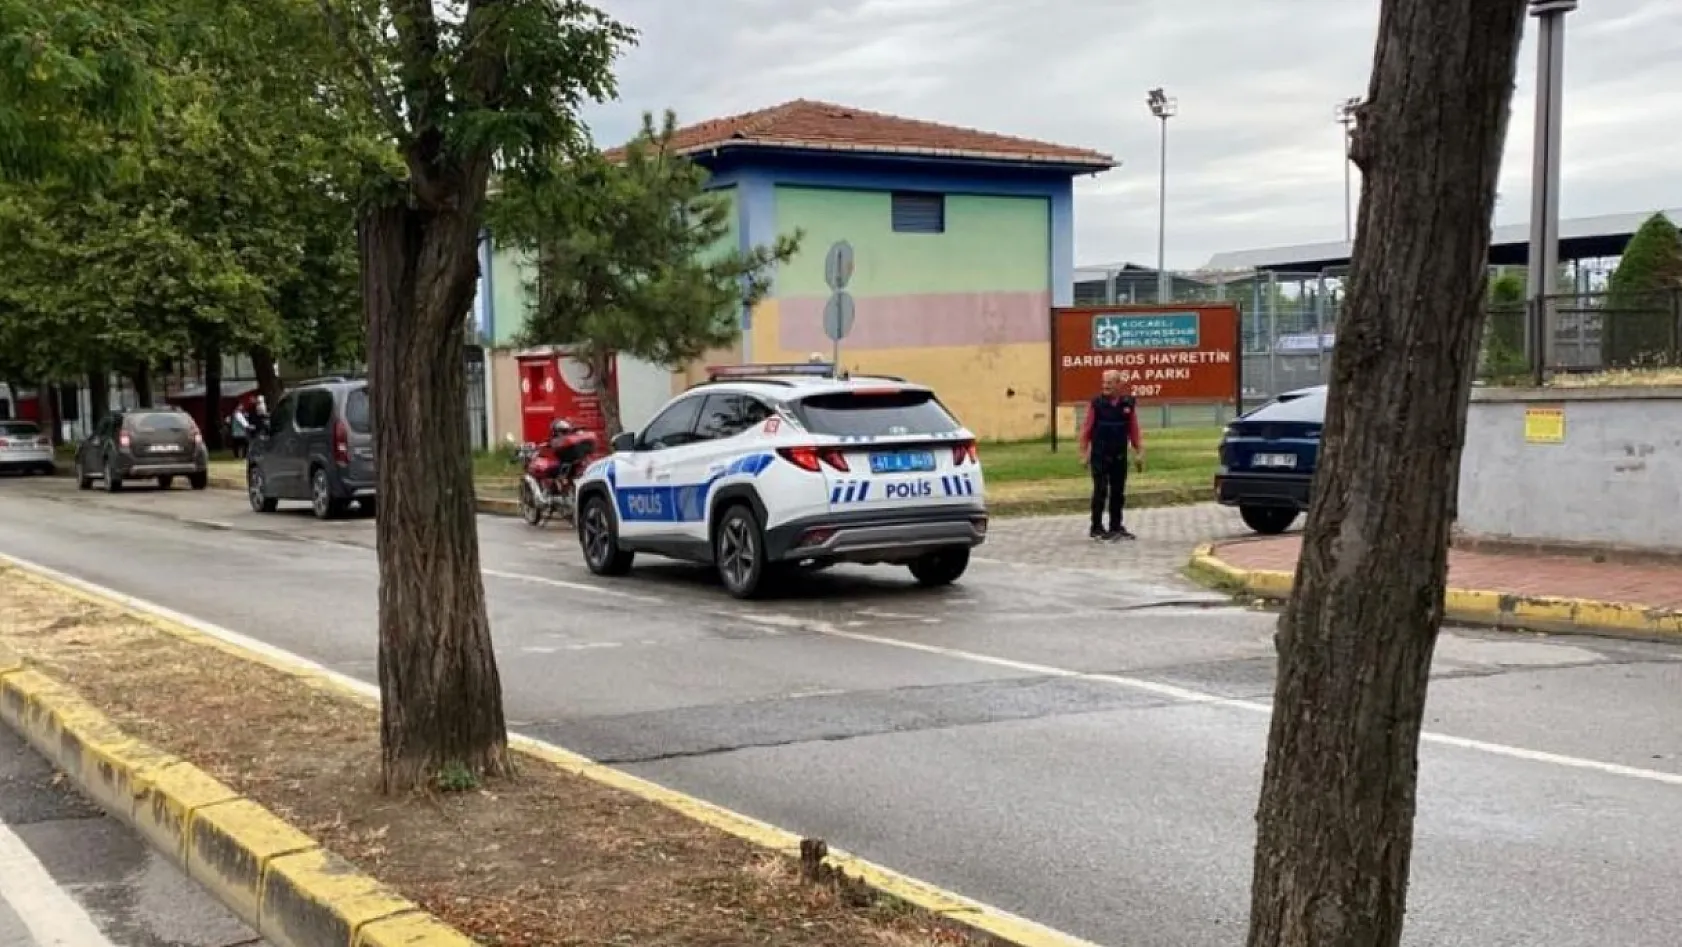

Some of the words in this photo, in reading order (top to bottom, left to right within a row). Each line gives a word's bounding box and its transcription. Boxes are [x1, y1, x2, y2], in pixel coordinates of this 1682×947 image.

[1062, 352, 1146, 367] BARBAROS
[1150, 349, 1230, 364] HAYRETTİN
[1145, 367, 1190, 381] PARKI
[1131, 384, 1162, 397] 2007
[886, 479, 932, 498] POLİS
